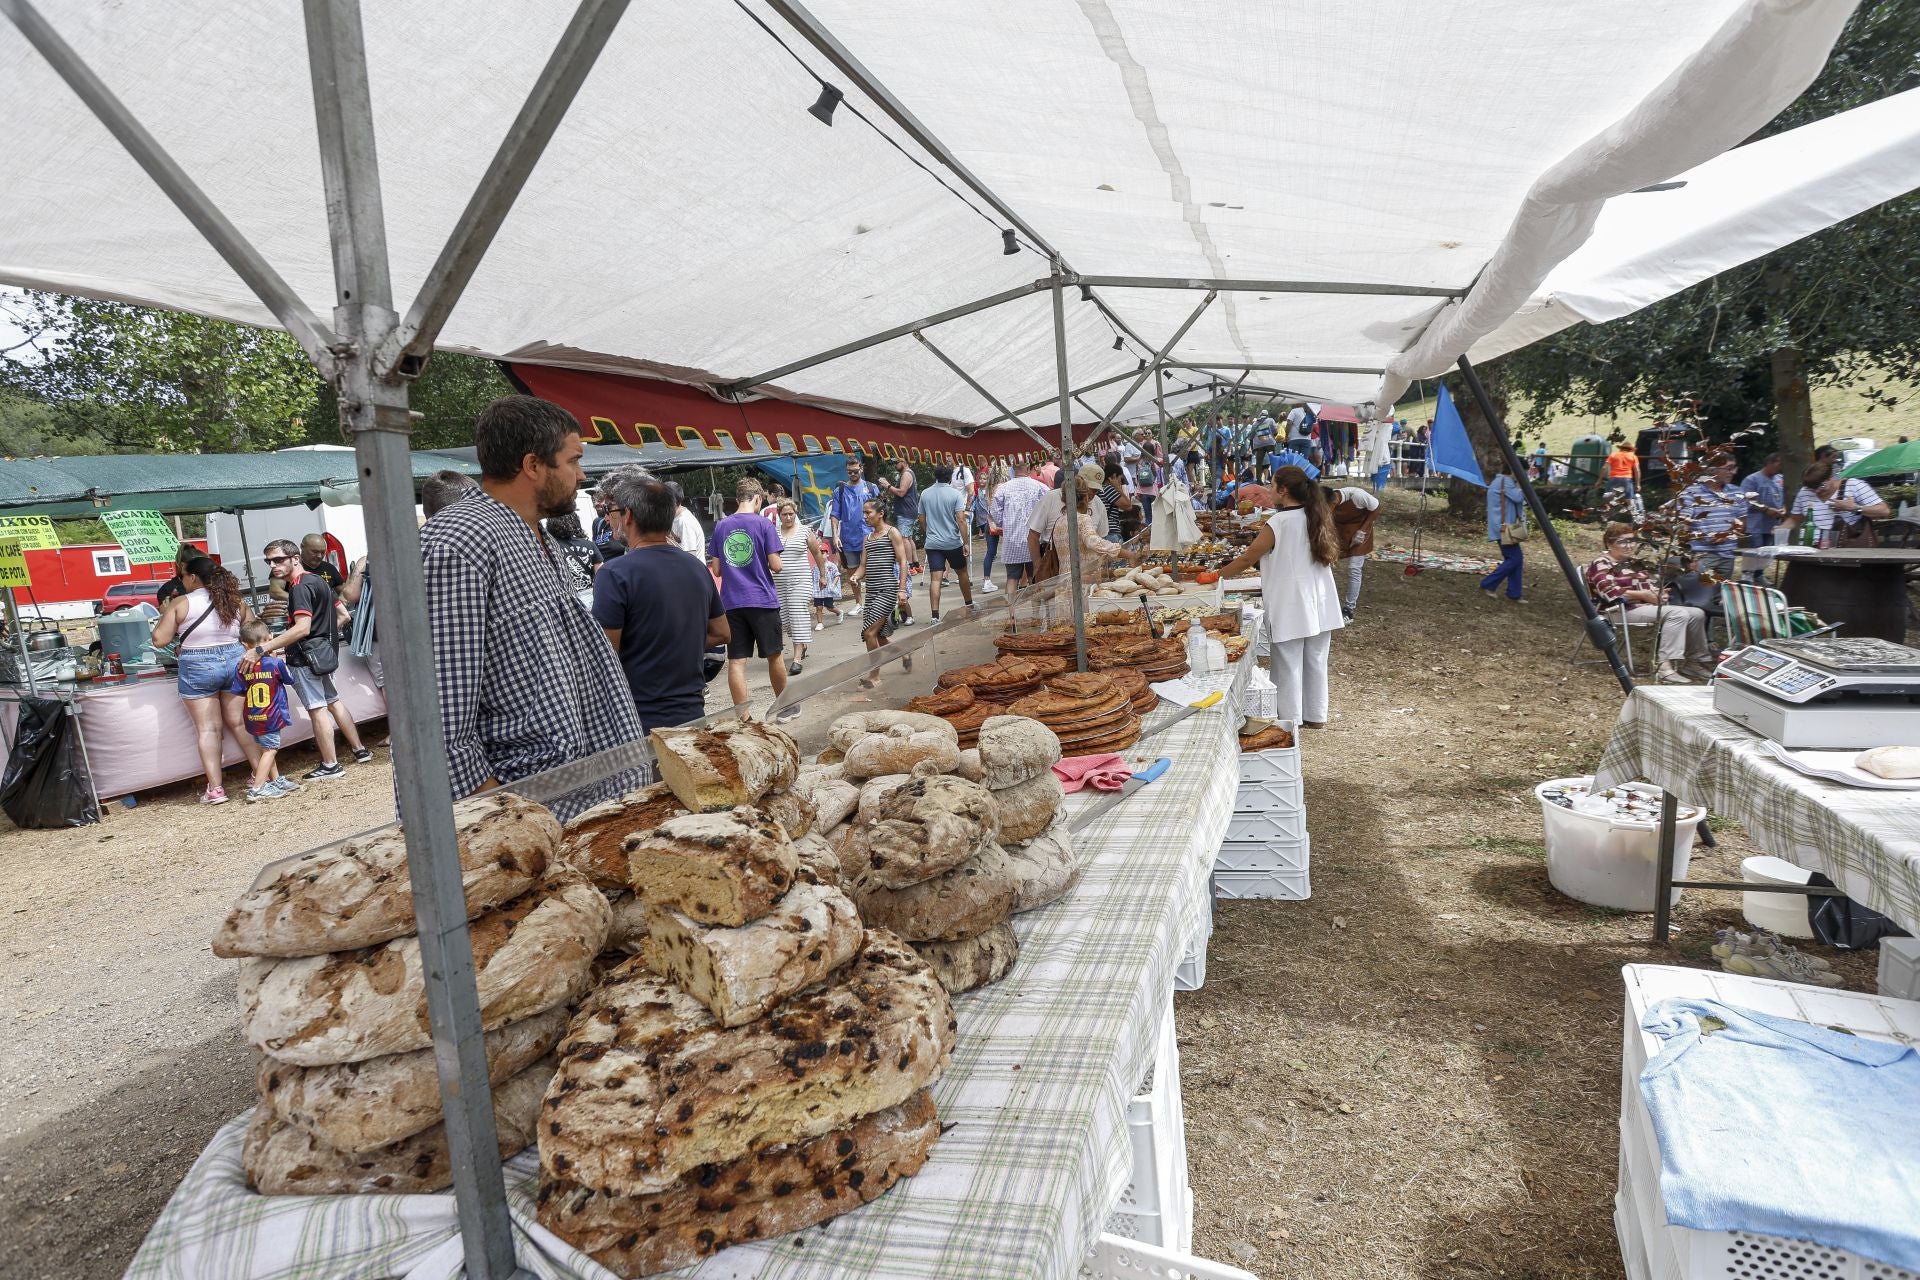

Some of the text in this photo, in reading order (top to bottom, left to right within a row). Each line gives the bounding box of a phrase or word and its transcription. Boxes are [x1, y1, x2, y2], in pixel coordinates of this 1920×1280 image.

[0, 516, 49, 527] IXTOS
[120, 537, 151, 547] LOMO
[126, 545, 161, 555] BACON
[0, 566, 26, 579] DE POTA
[246, 682, 270, 708] 10
